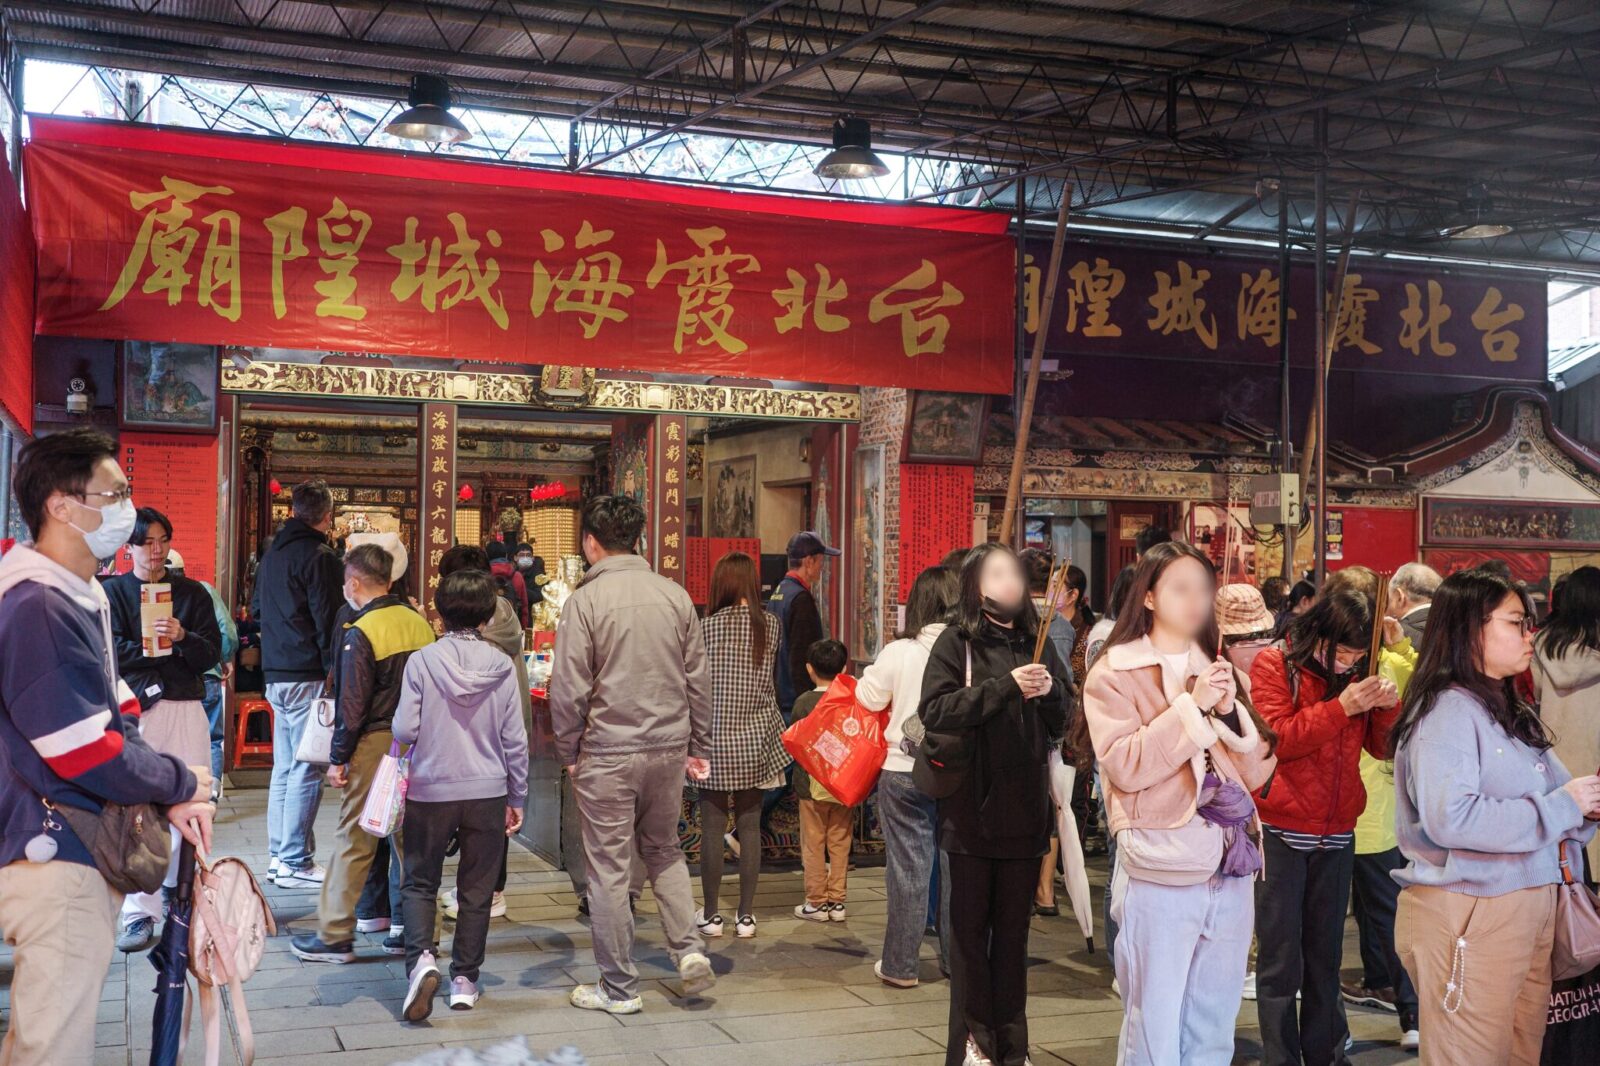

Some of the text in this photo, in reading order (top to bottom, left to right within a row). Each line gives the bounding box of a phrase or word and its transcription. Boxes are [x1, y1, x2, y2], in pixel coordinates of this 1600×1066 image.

[99, 176, 965, 357] 台北霞海城隍廟
[663, 422, 682, 581] 霞彩臨門八蜡配
[1546, 998, 1600, 1025] GEOGRA
